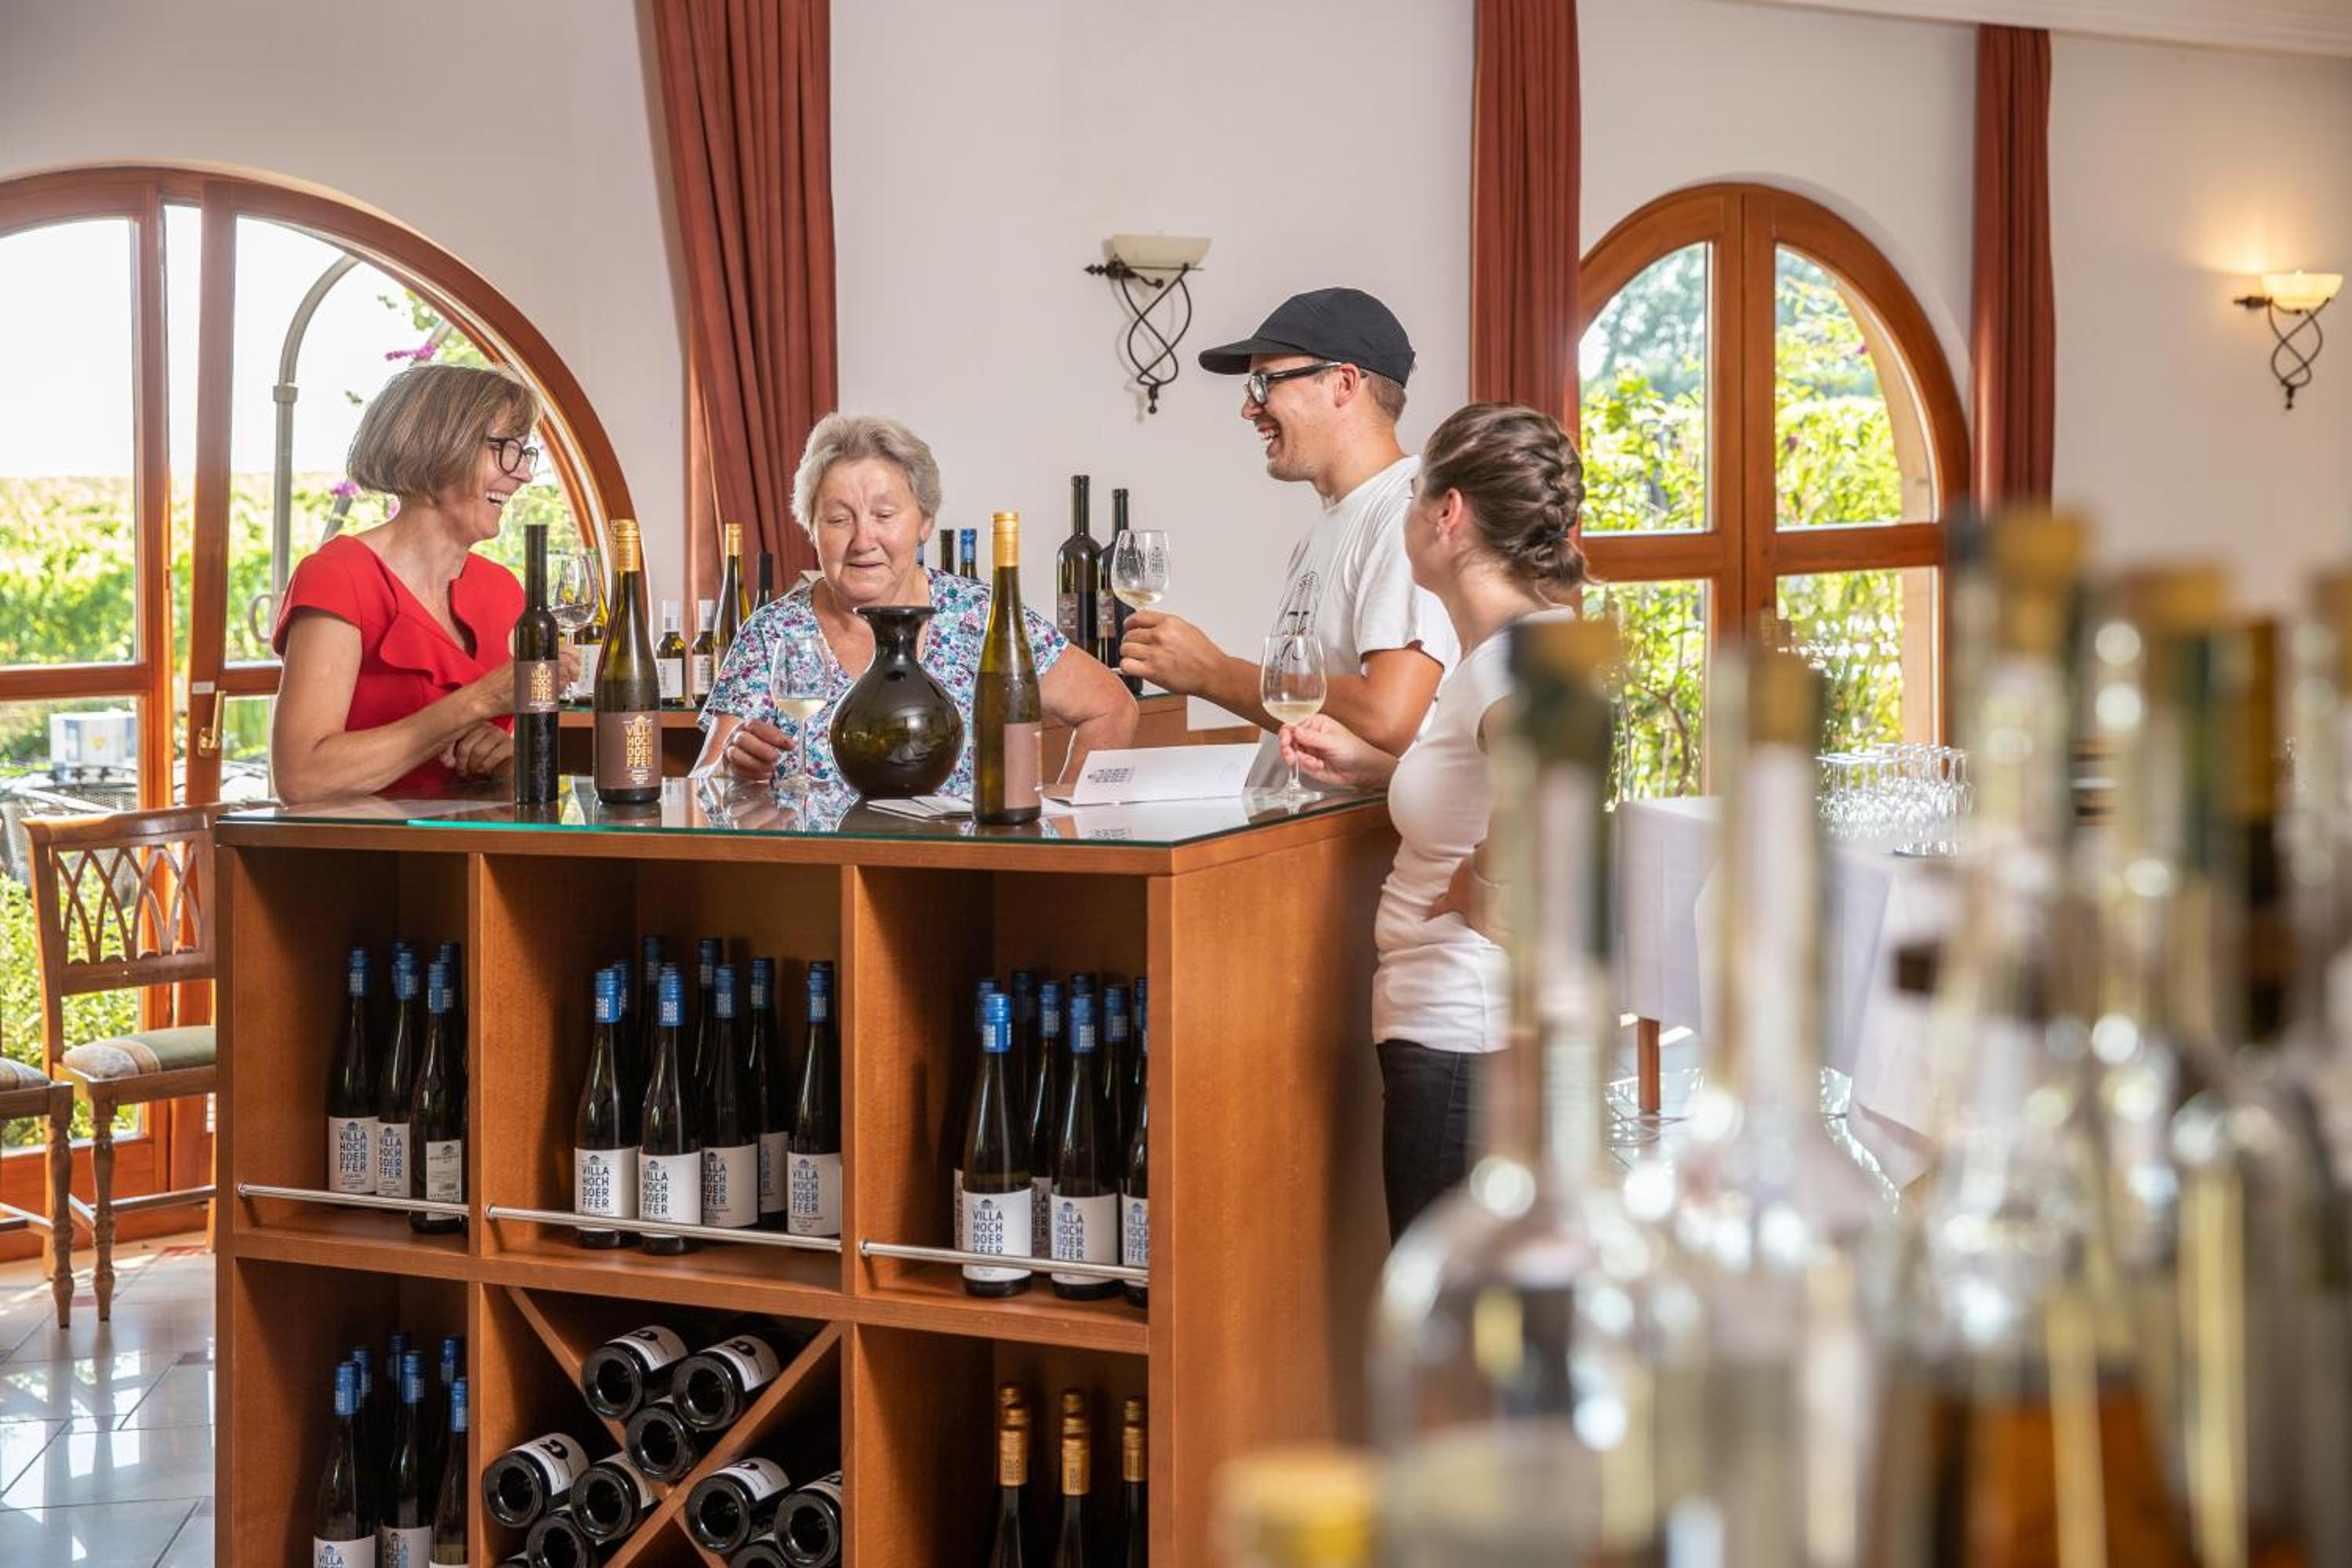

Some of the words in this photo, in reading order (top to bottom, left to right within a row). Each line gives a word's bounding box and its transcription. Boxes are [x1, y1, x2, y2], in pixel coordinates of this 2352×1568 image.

[339, 1142, 367, 1152] HOCH
[339, 1152, 367, 1161] DOER
[339, 1163, 367, 1172] FFER
[583, 1166, 611, 1176] VILLA
[642, 1171, 669, 1181] VILLA
[792, 1169, 819, 1180] VILLA
[583, 1177, 610, 1186] HOCH
[642, 1181, 668, 1192] HOCH
[793, 1181, 818, 1191] HOCH
[583, 1188, 610, 1197] DOER
[642, 1193, 668, 1203] DOER
[583, 1199, 610, 1208] FFER
[642, 1203, 668, 1214] FFER
[793, 1203, 818, 1214] FFER
[973, 1210, 1004, 1221] VILLA
[1057, 1213, 1083, 1224] VILLA
[973, 1222, 1004, 1232] HOCH
[1057, 1225, 1083, 1236] HOCH
[973, 1233, 1004, 1244] DOER
[318, 1555, 344, 1565] VILLA
